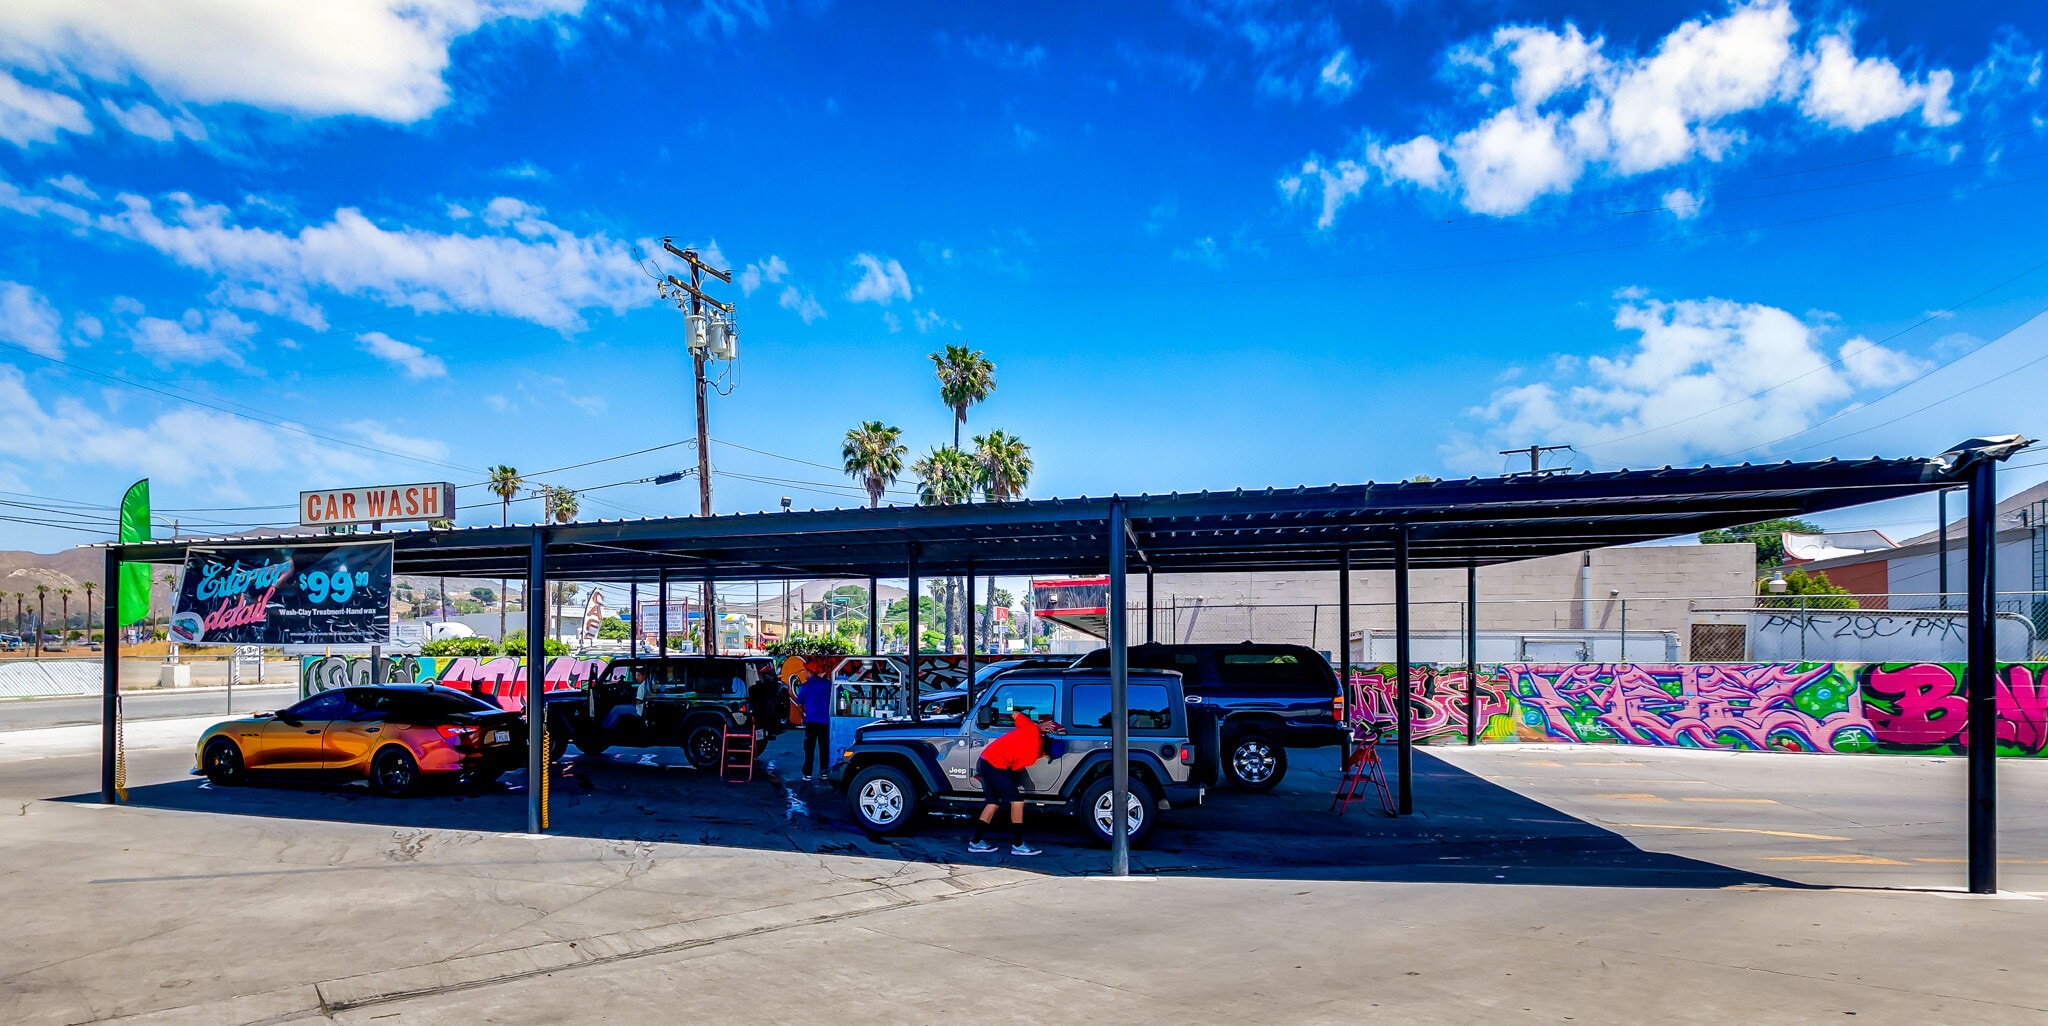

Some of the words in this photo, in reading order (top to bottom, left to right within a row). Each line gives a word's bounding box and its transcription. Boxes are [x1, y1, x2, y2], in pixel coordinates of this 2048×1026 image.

[307, 493, 356, 522] CAR
[366, 486, 438, 518] WASH
[197, 558, 291, 601] Exterior
[204, 586, 276, 632] detail
[279, 608, 312, 617] Wash-Clay
[312, 607, 363, 616] Treatment-Hand
[949, 766, 966, 775] Jeep
